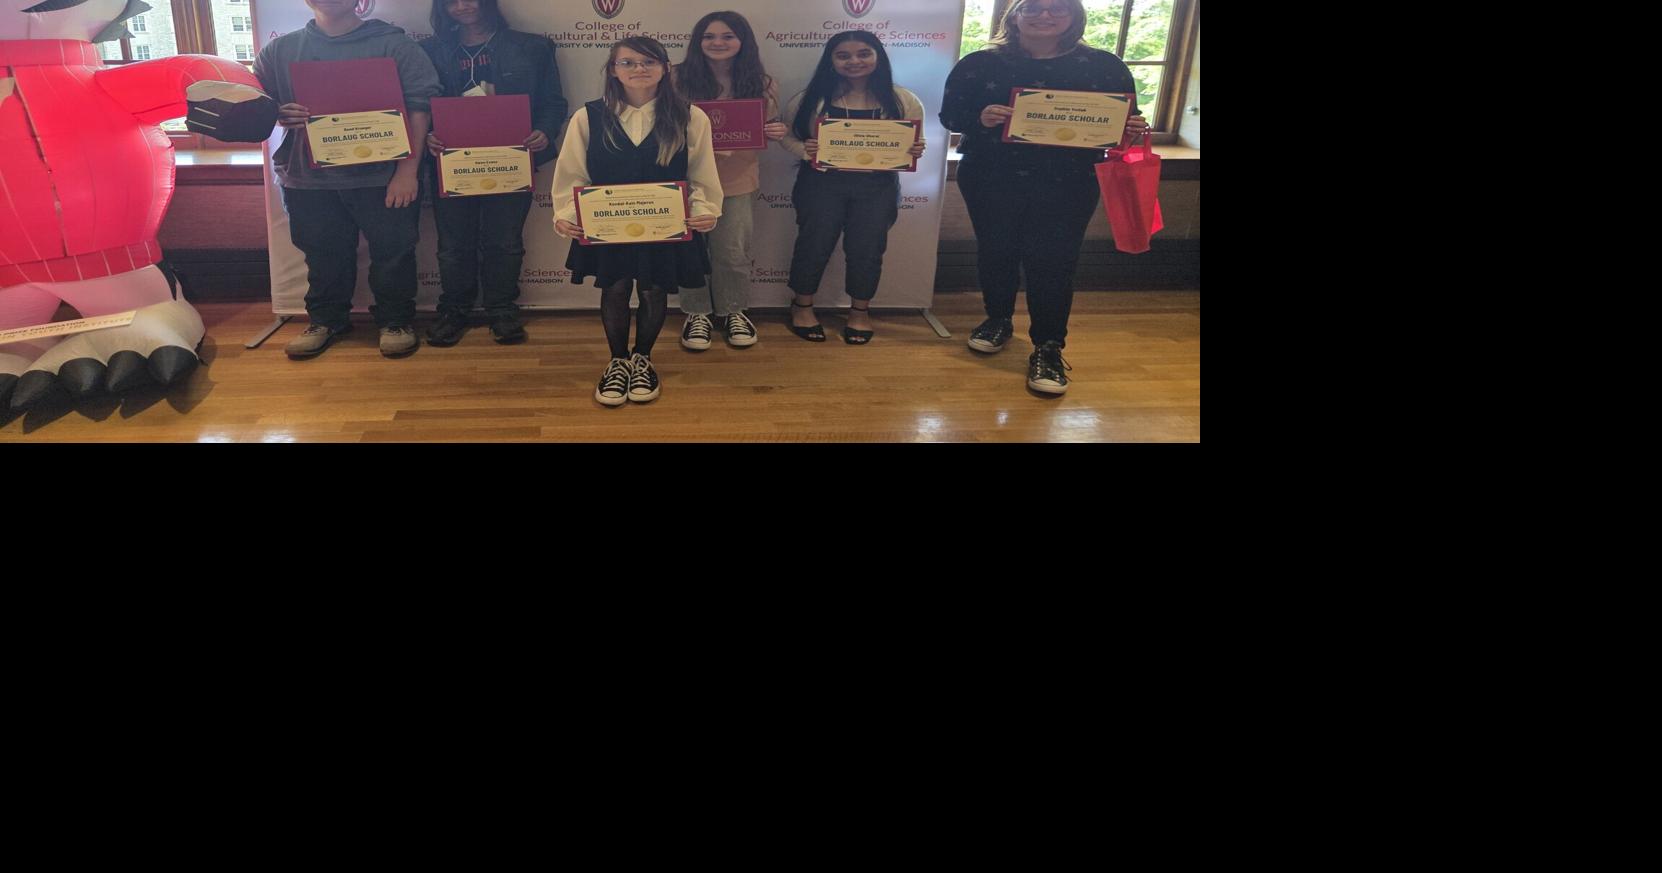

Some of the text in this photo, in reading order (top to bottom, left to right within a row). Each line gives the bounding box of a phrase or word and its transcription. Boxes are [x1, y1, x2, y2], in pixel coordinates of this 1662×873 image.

[575, 21, 641, 32] College of
[823, 20, 890, 31] College of
[600, 32, 610, 41] &
[642, 32, 691, 41] Science
[765, 31, 833, 42] Agricultur
[889, 31, 946, 40] Sciences
[1026, 112, 1066, 121] BORLAUG
[1068, 114, 1110, 124] SCHOLAR
[322, 130, 394, 143] BORLAUG SCHOLAR
[713, 131, 752, 140] ONSIN
[829, 139, 900, 148] BORLAUG SCHOLAR
[453, 165, 519, 175] BORLAUG SCHOLAR
[593, 207, 670, 218] BORLAUG SCHOLAR
[755, 268, 789, 277] Scien
